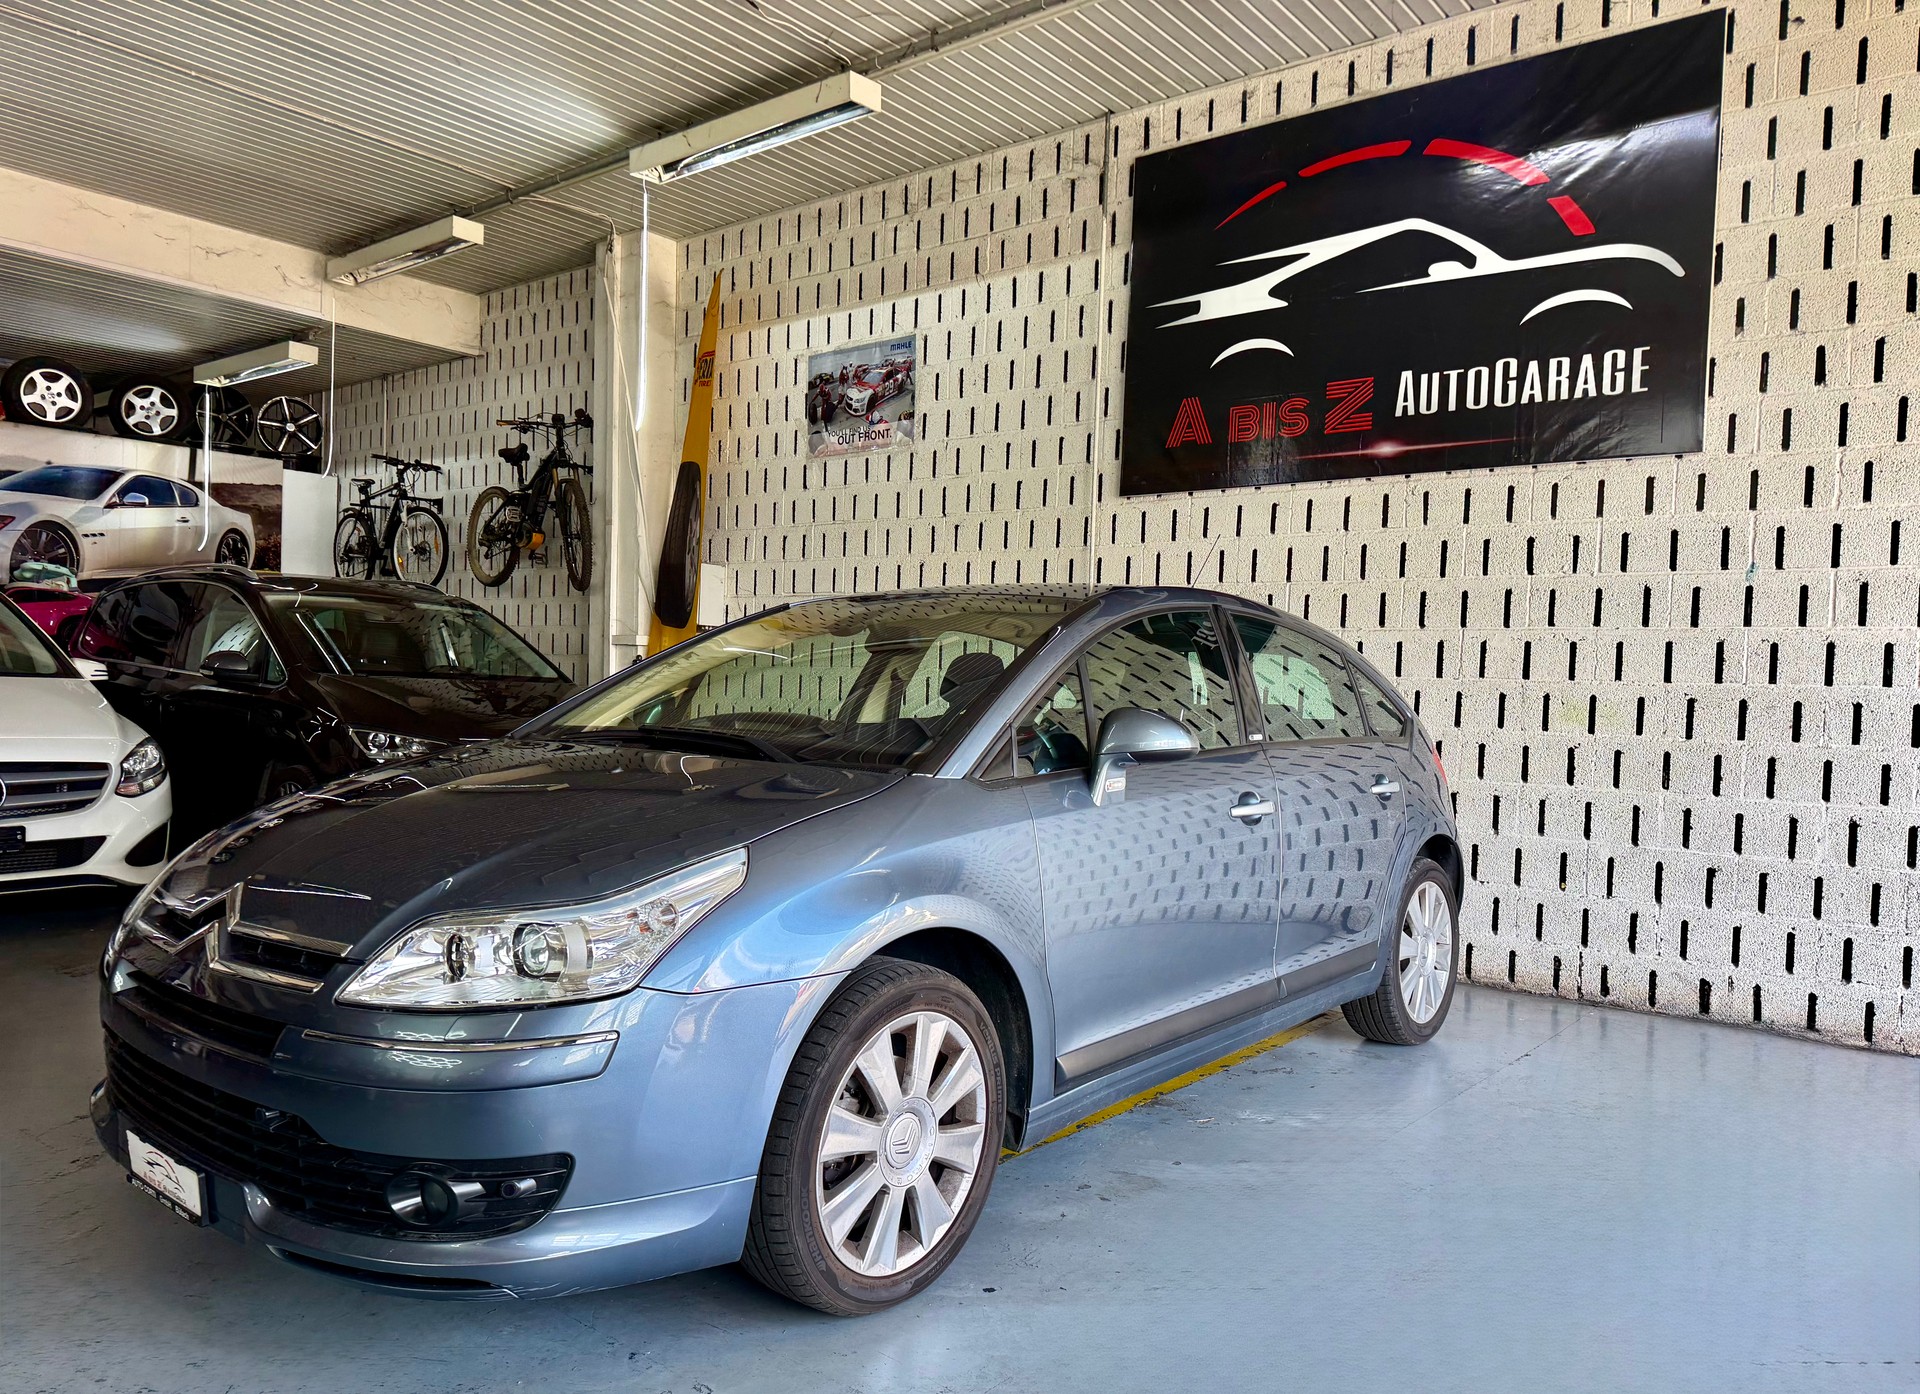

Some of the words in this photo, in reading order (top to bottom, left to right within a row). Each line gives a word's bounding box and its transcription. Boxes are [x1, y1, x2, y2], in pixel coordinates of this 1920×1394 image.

[890, 341, 912, 351] MAHLE
[1165, 396, 1212, 448] A
[1324, 377, 1374, 435] Z
[838, 433, 856, 445] OUT
[858, 428, 892, 442] FRONT.
